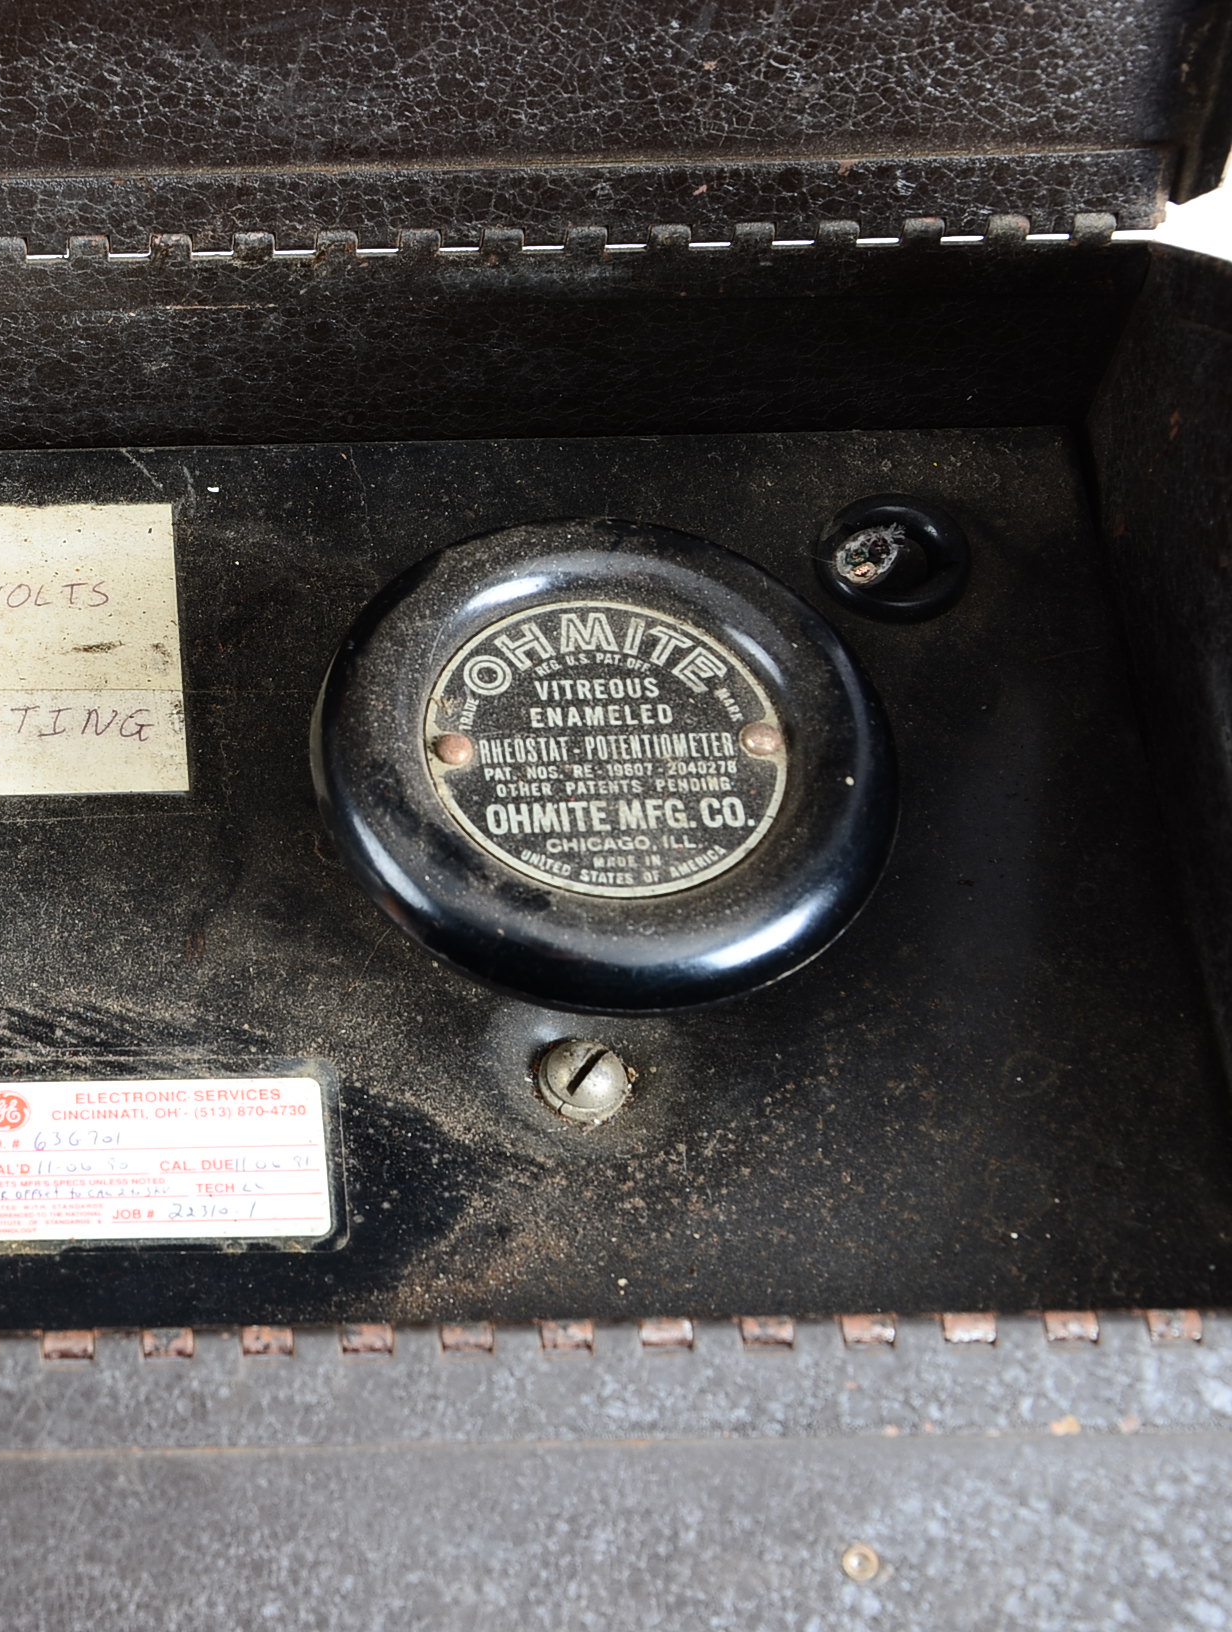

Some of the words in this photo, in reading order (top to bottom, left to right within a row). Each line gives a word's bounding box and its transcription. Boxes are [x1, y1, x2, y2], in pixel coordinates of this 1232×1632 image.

[463, 612, 728, 696] OHMITE
[534, 659, 563, 677] REG.
[595, 652, 624, 665] PAT.
[626, 657, 652, 674] OFF.
[534, 677, 660, 701] VITREOUS
[458, 697, 480, 731] TRADE
[713, 687, 745, 722] MARK
[530, 704, 674, 728] ENAMELED
[484, 766, 518, 781] PAT.
[527, 764, 565, 779] NOS.
[496, 781, 553, 798] OTHER
[565, 778, 643, 796] PATENTS
[486, 800, 611, 835] OHMITE
[620, 797, 697, 831] MFG.
[701, 795, 756, 828] CO.
[546, 835, 657, 854] CHICAGO,
[520, 848, 572, 876] UNITED
[579, 869, 634, 885] STATES
[643, 869, 661, 884] OF
[669, 844, 727, 879] AMERICA
[593, 855, 639, 869] MADE
[645, 853, 662, 867] IN
[75, 1090, 188, 1105] ELECTRONIC
[193, 1088, 282, 1102] SERVICES
[51, 1107, 149, 1121] CINCINNATI,
[155, 1106, 180, 1119] OH
[194, 1105, 233, 1120] (513)
[237, 1104, 307, 1117] 870-4730
[11, 1138, 21, 1149] #
[200, 1158, 235, 1171] DUE
[53, 1178, 87, 1187] SPECS
[89, 1177, 129, 1186] UNLESS
[131, 1177, 166, 1185] NOTED
[196, 1182, 235, 1194] TECH
[112, 1208, 142, 1220] JOB
[146, 1209, 155, 1219] #
